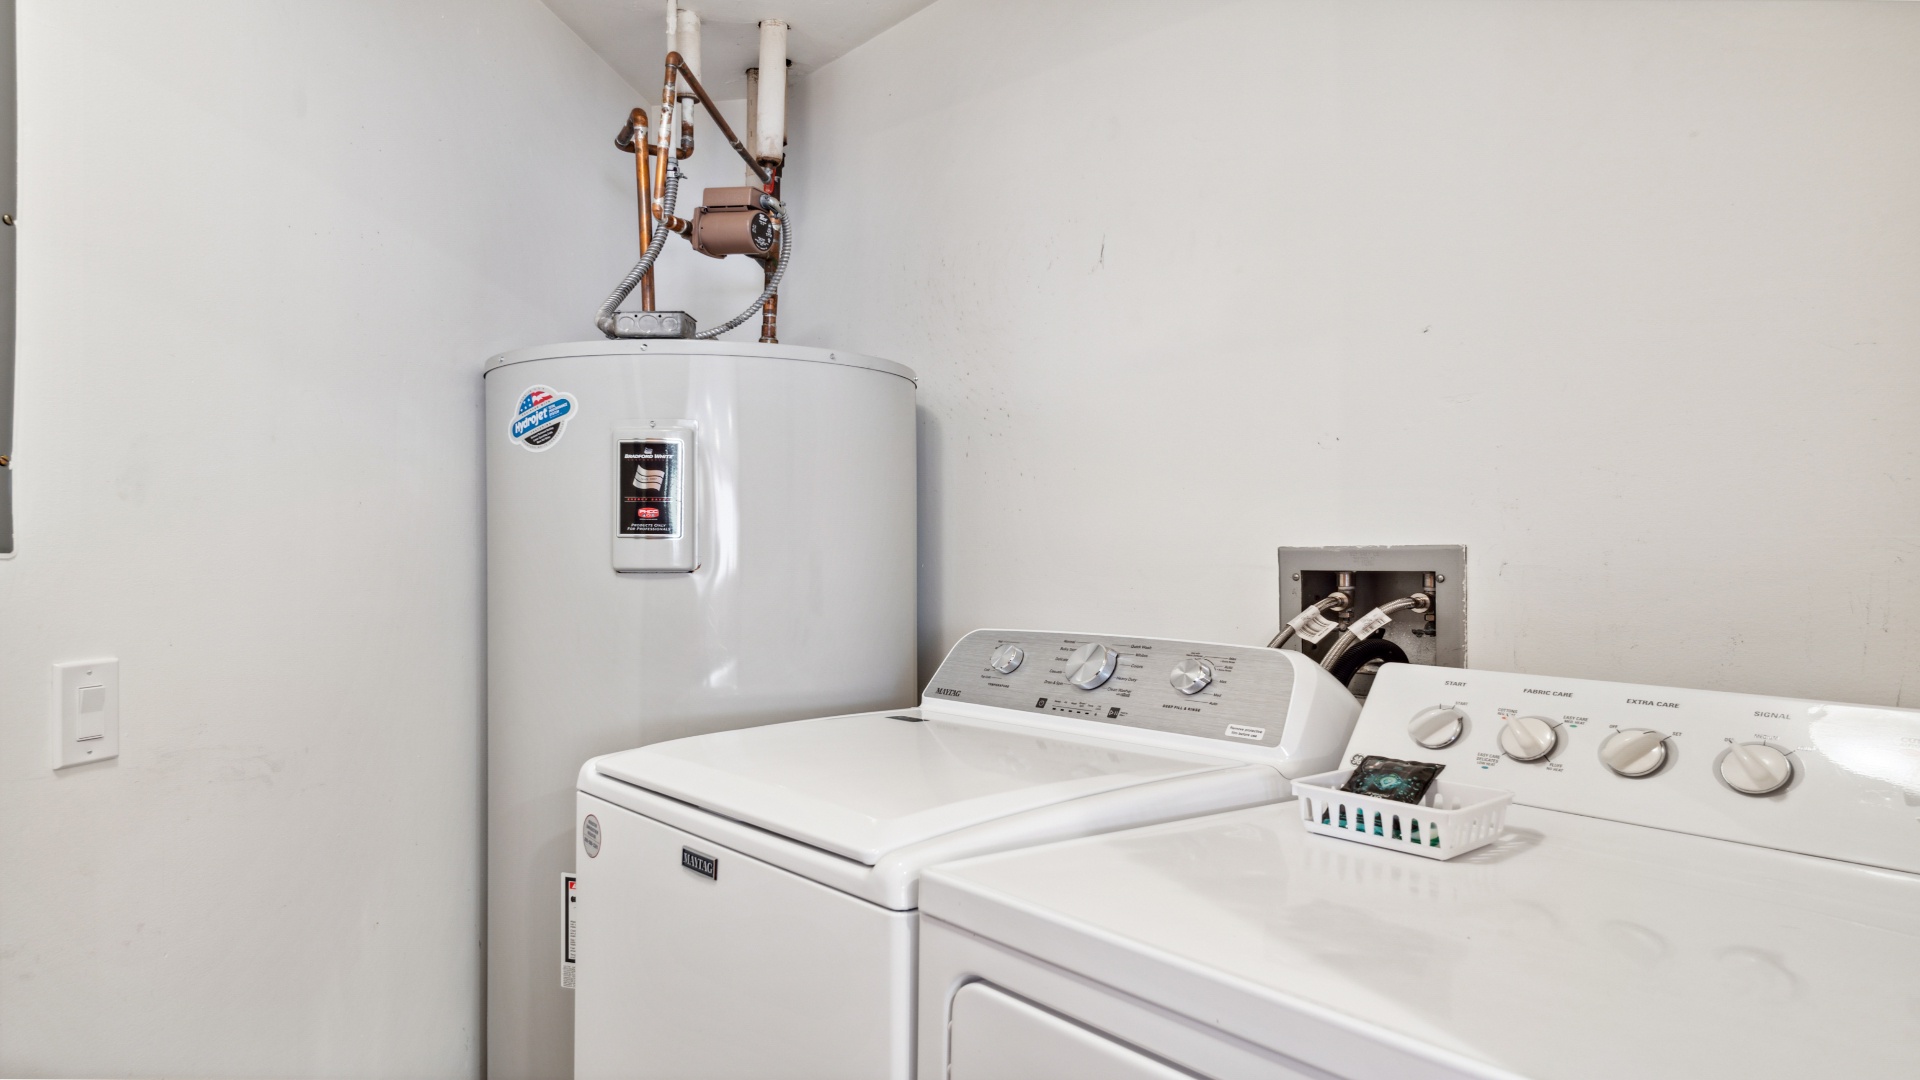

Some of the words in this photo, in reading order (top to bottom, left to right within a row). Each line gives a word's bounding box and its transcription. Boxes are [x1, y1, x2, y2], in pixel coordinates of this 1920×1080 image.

[514, 406, 548, 434] Hydrojet
[935, 687, 962, 697] MAYTAG
[1523, 688, 1551, 697] FABRIC
[1626, 698, 1654, 707] EXTRA
[1656, 701, 1680, 709] CARE
[1753, 710, 1791, 720] SIGNAL
[683, 851, 713, 874] MAYTAG
